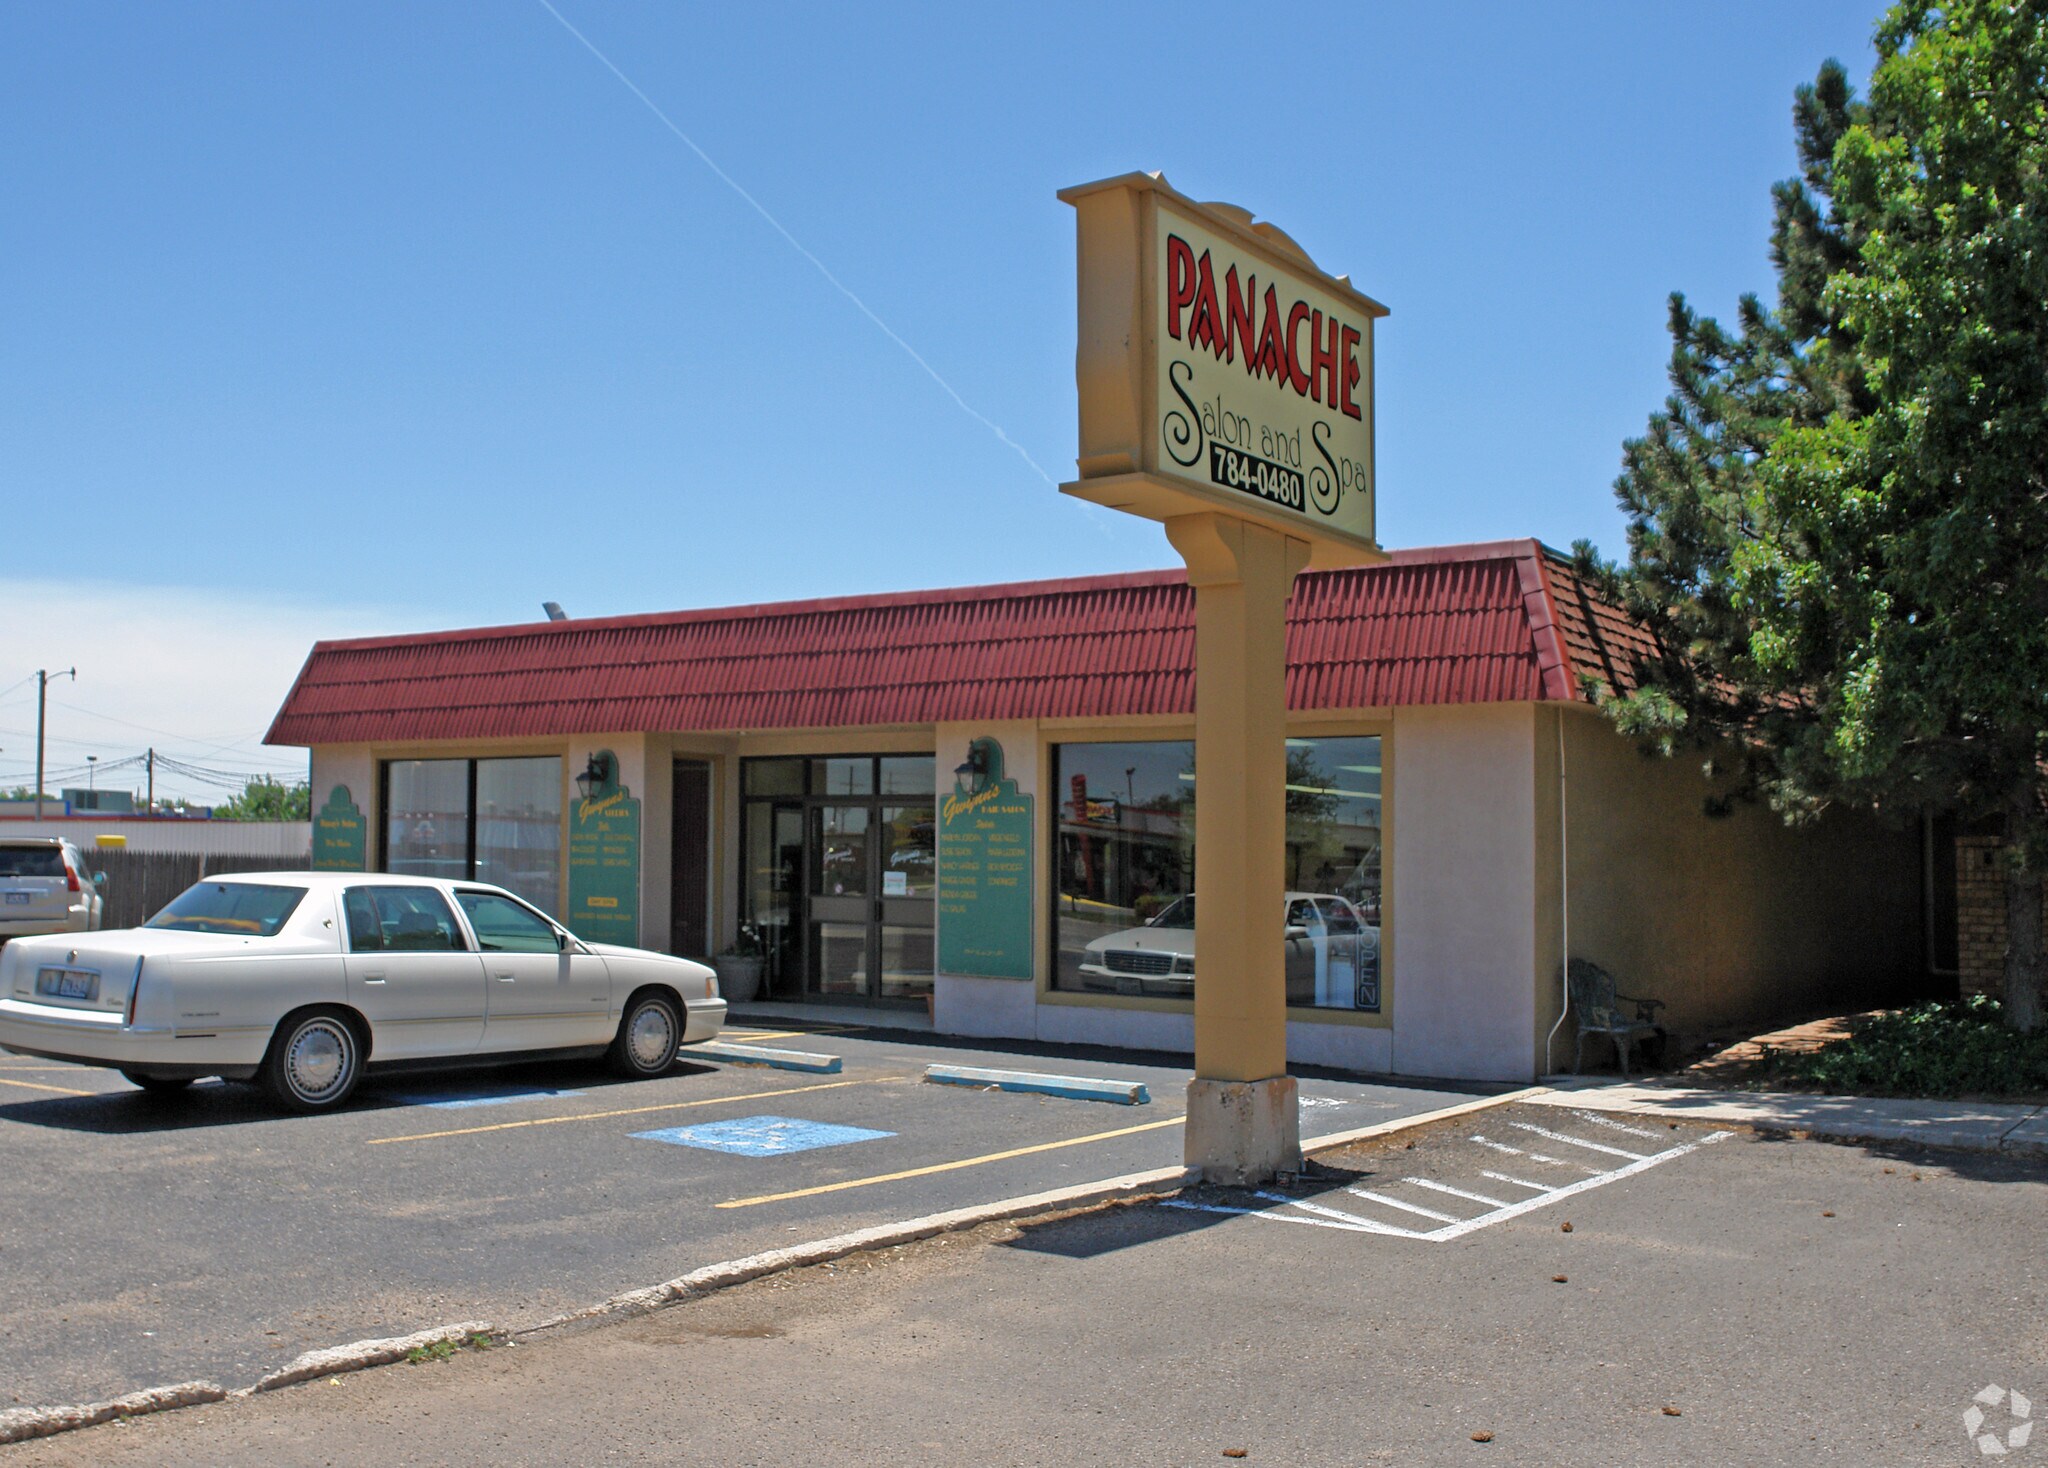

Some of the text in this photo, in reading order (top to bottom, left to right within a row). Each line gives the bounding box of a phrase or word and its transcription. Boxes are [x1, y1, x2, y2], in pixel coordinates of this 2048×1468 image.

[1168, 233, 1362, 422] PANACHE
[1163, 360, 1367, 516] Salon and Spa
[1214, 449, 1301, 508] 784-0480
[1360, 930, 1377, 1004] OPEN
